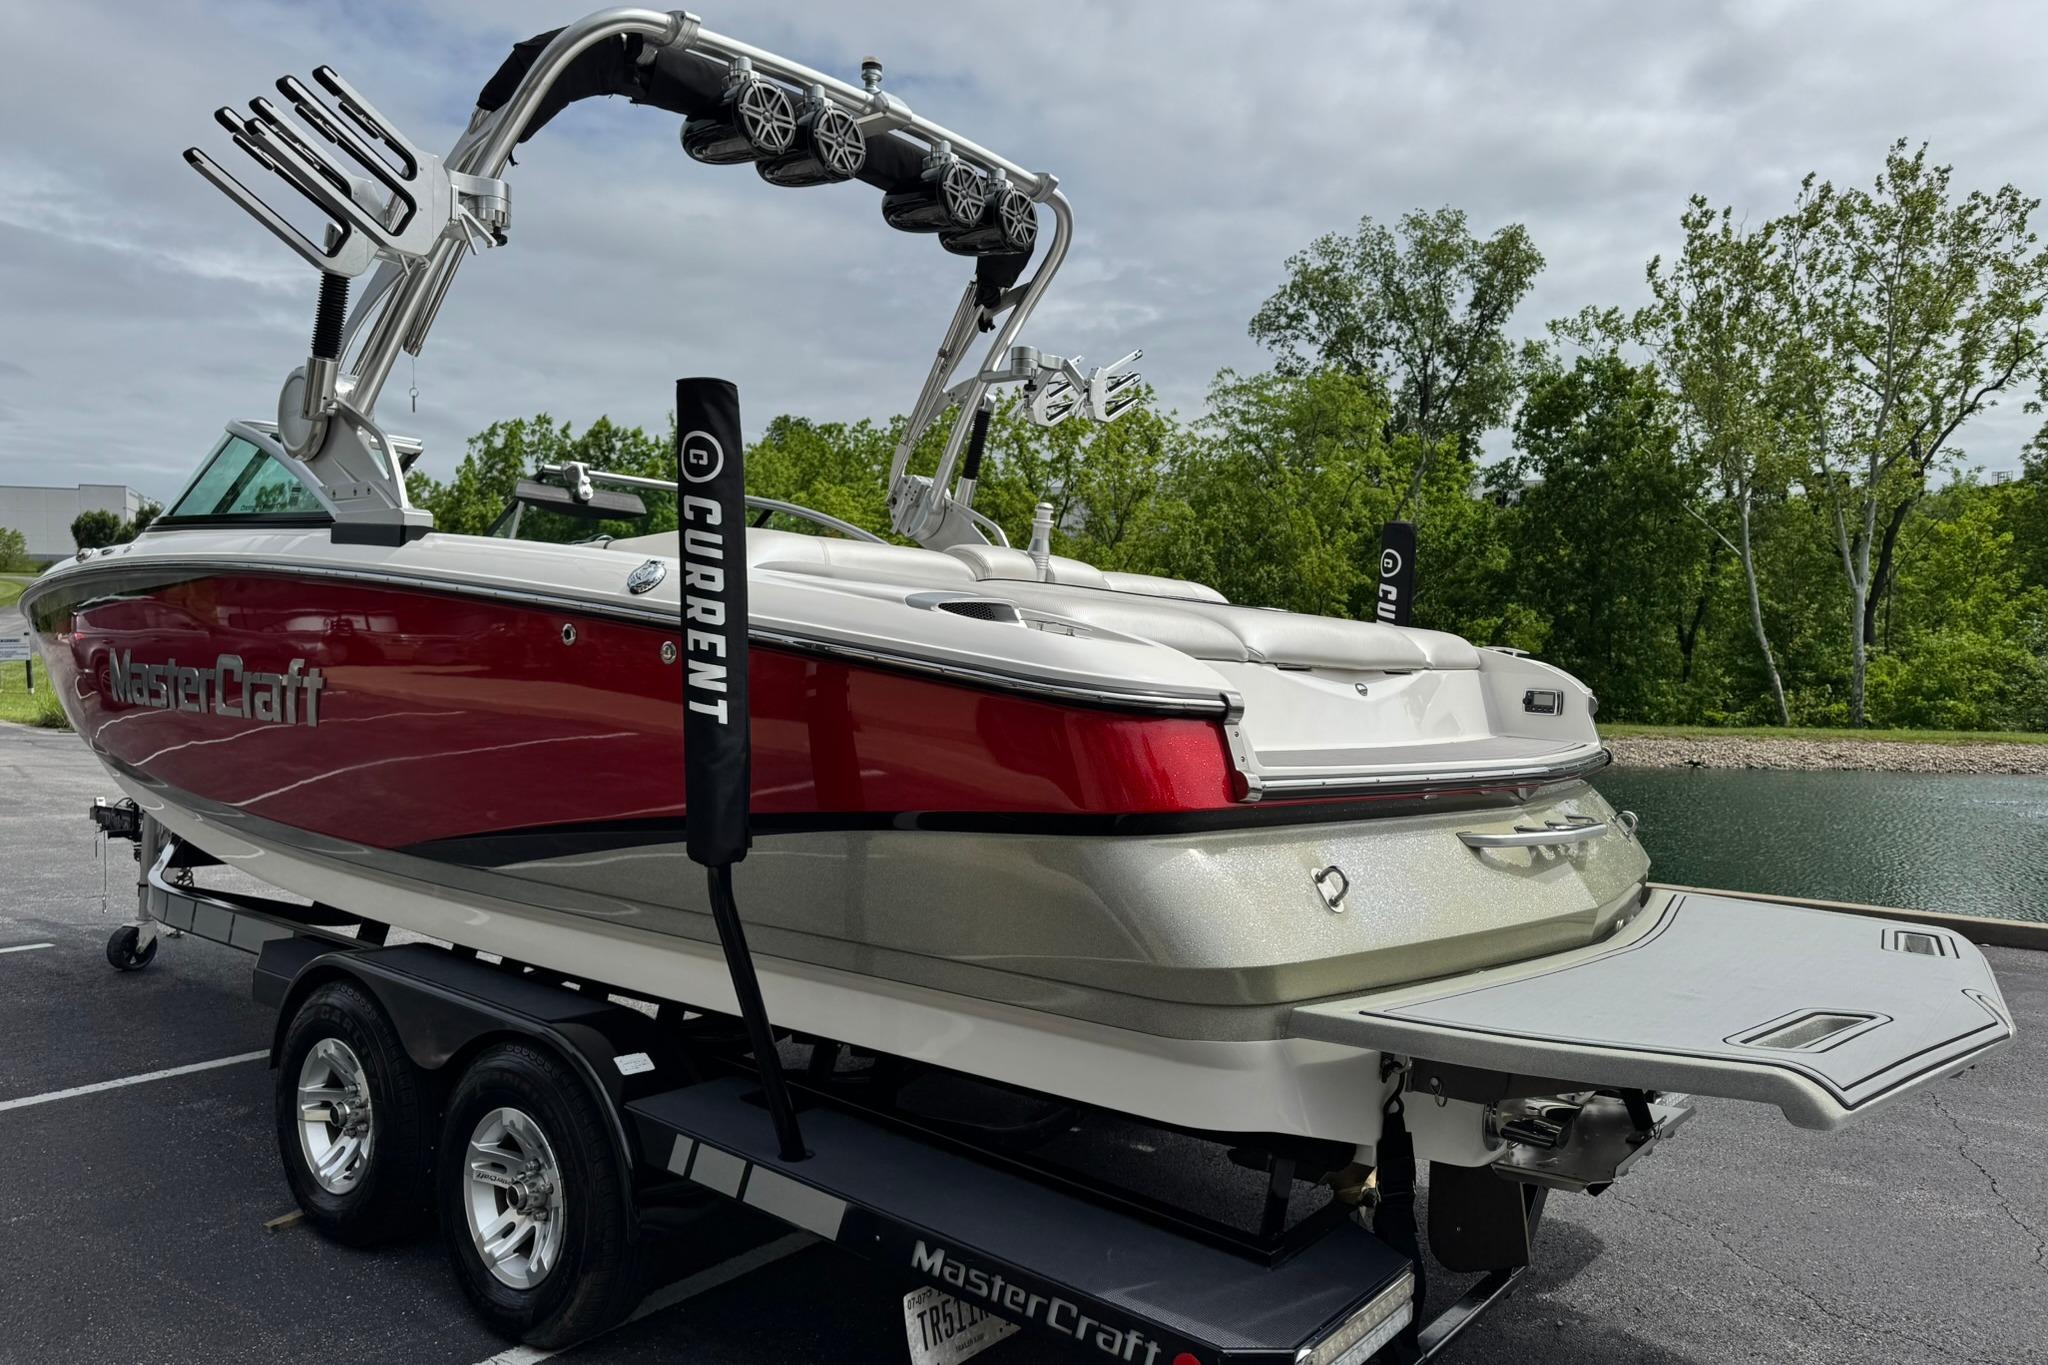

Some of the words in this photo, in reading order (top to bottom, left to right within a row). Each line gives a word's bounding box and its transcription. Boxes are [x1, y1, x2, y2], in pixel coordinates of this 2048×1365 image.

[683, 494, 729, 725] CURRENT
[1376, 582, 1398, 626] CU
[109, 648, 326, 727] MasterCraft
[910, 1239, 1162, 1365] MasterCraft
